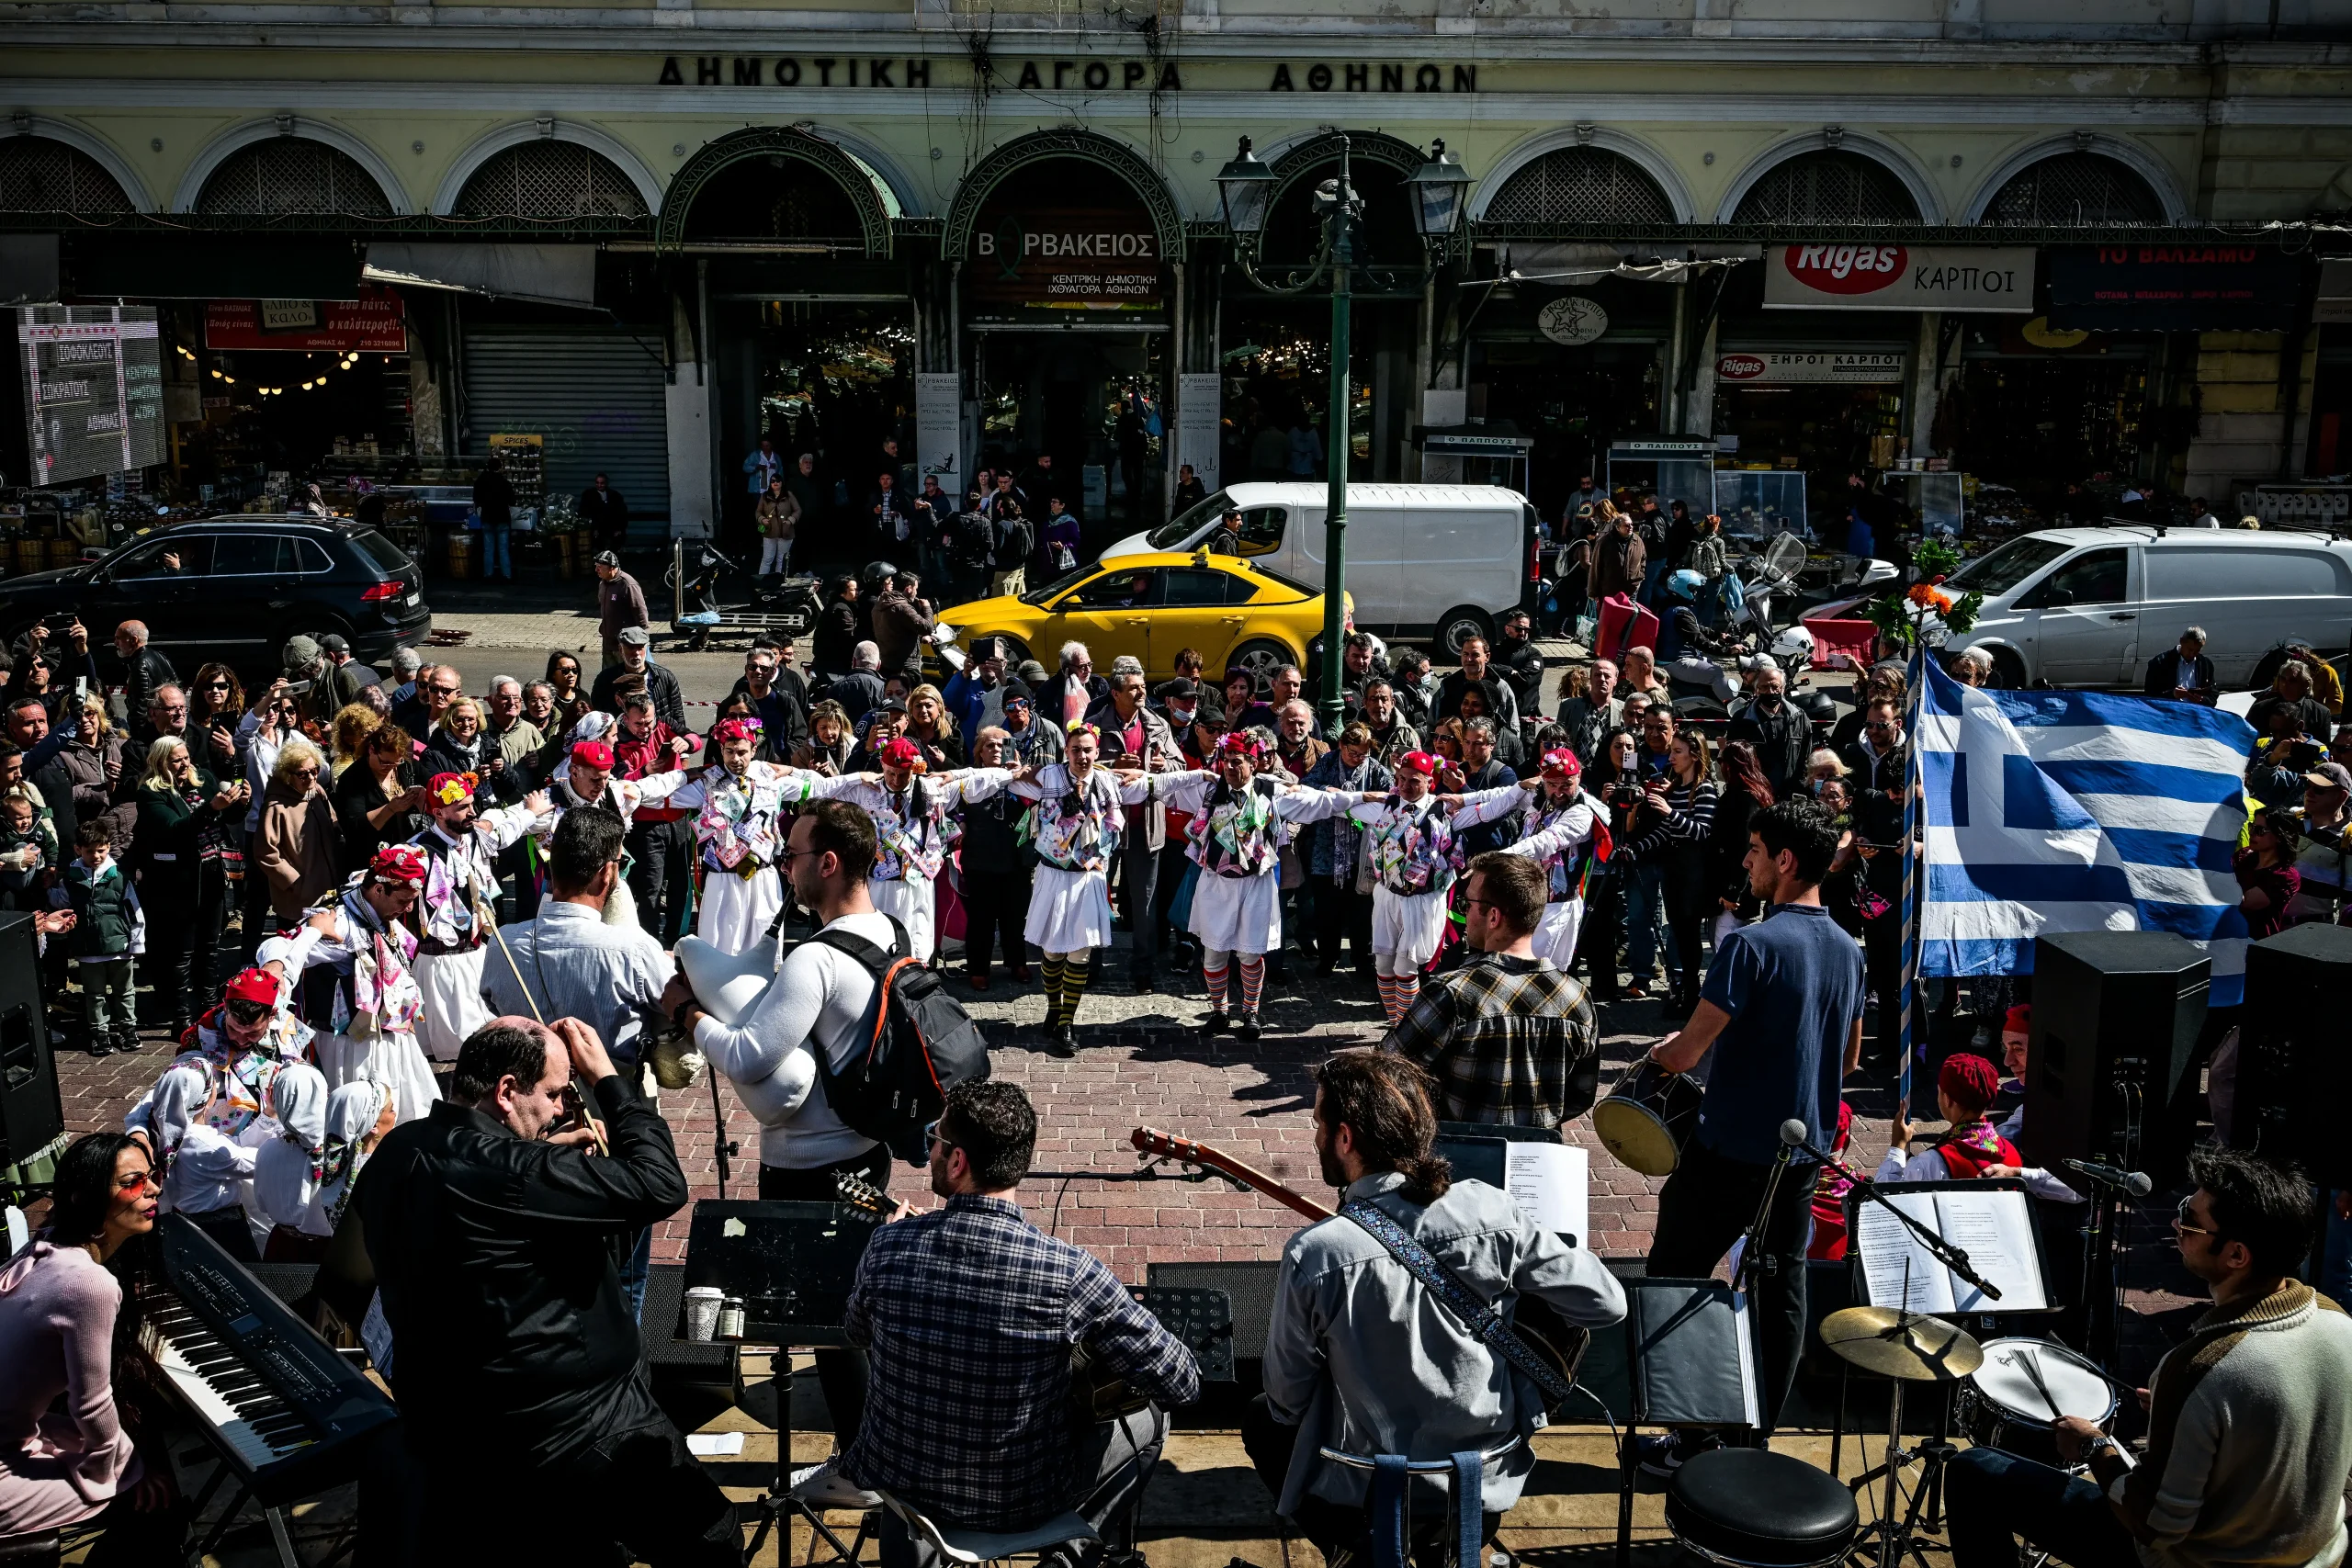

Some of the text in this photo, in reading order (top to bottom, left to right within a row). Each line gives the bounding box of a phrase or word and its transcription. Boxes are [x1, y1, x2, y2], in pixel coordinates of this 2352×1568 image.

[659, 56, 1476, 93] ΔΗΜΟΤΙΚΗ ΑΓΟΡΑ ΑΘΗΝΩΝ
[1796, 245, 1898, 279] Rigas
[1052, 275, 1157, 285] ΚΕΝΤΡΙΚΗ ΔΗΜΟΤΙΚΗ
[1914, 266, 2015, 292] ΚΑΡΠΟΙ
[1048, 285, 1149, 294] ΙΧΘΥΑΓΟΡΑ ΑΘΗΝΩΝ
[1572, 299, 1607, 320] ΚΑΡΠΟΙ
[1770, 355, 1901, 365] ΞΗΡΟΙ ΚΑΡΠΟΙ
[1721, 359, 1761, 375] Rigas
[503, 436, 528, 445] SPICES
[1461, 436, 1513, 445] ΠΑΠΠΟΥΣ
